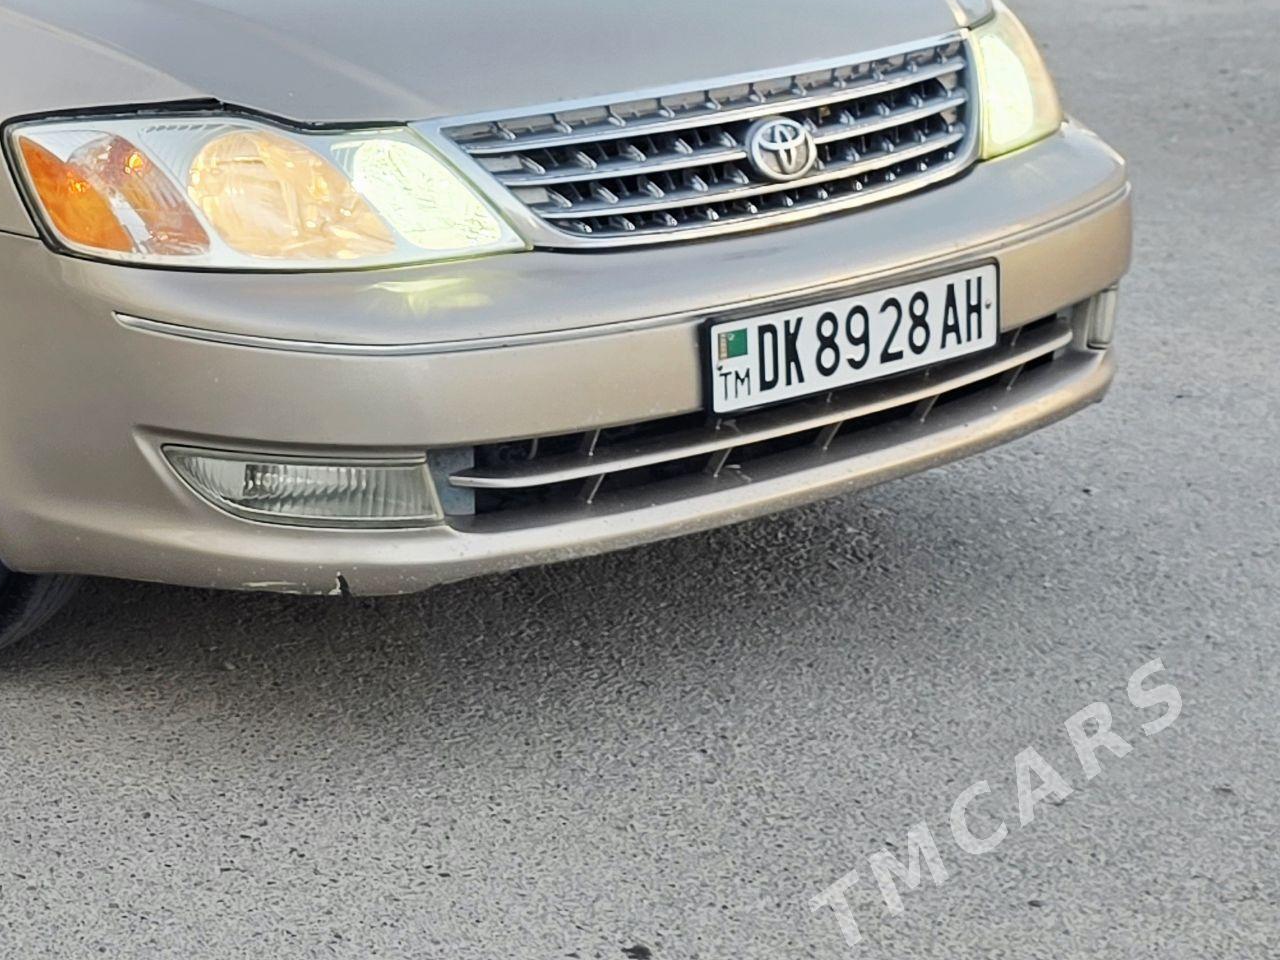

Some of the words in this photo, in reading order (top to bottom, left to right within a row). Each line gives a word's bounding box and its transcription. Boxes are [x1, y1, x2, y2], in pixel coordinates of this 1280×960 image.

[757, 316, 806, 392] DK
[815, 290, 931, 377] 8928
[939, 275, 983, 350] AH
[719, 367, 752, 401] TM
